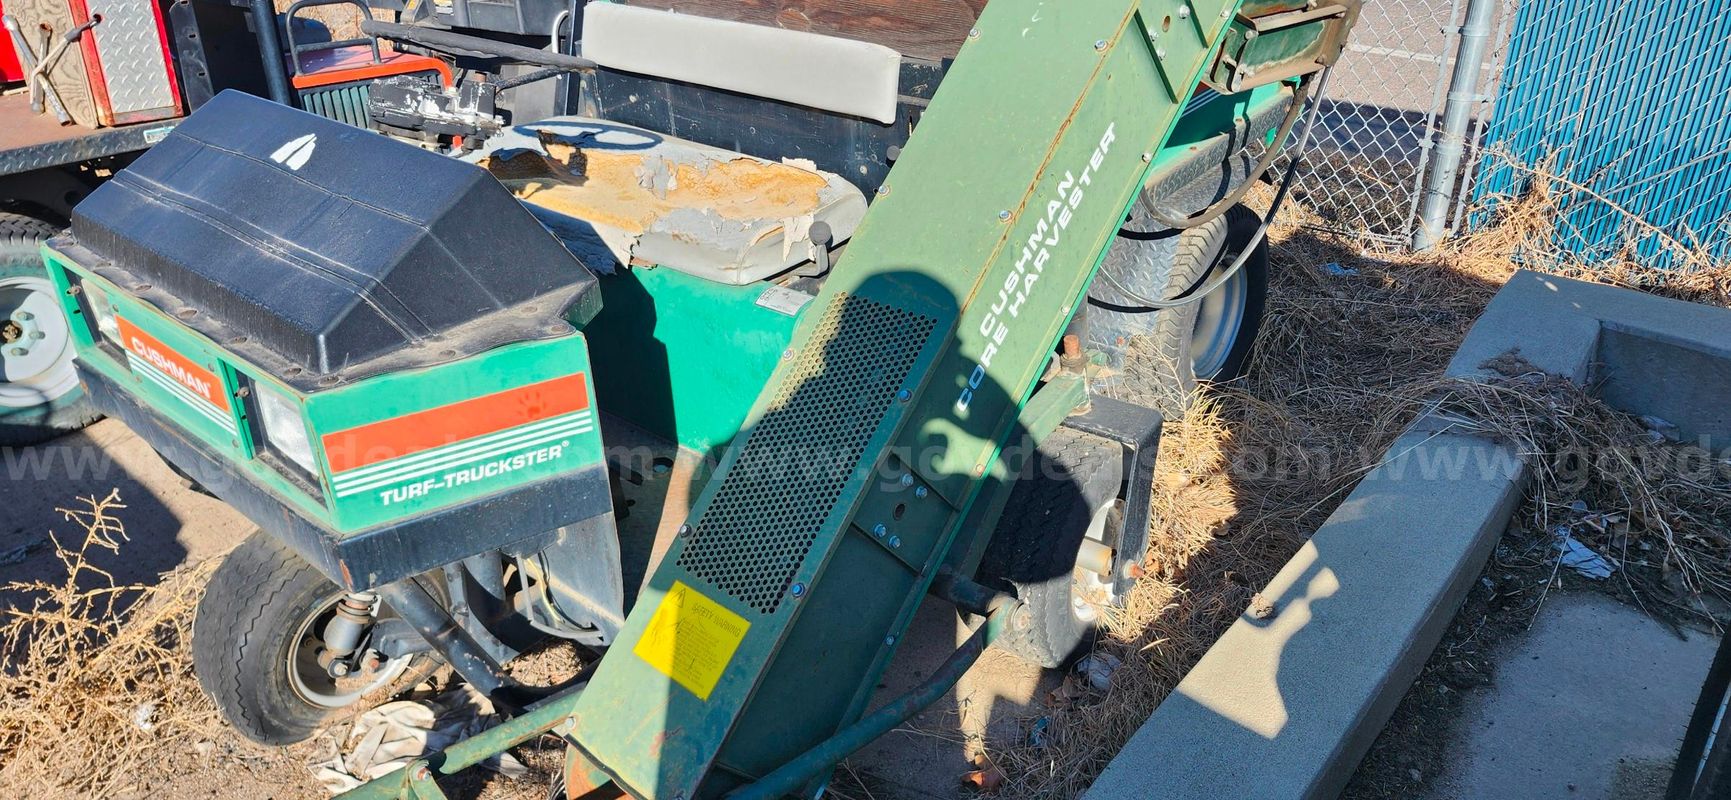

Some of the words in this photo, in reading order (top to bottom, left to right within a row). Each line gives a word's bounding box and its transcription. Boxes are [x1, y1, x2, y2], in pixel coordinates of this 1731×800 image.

[956, 322, 1009, 412] CORE
[1008, 122, 1116, 318] HARVESTER
[980, 170, 1075, 338] CUSHMAN
